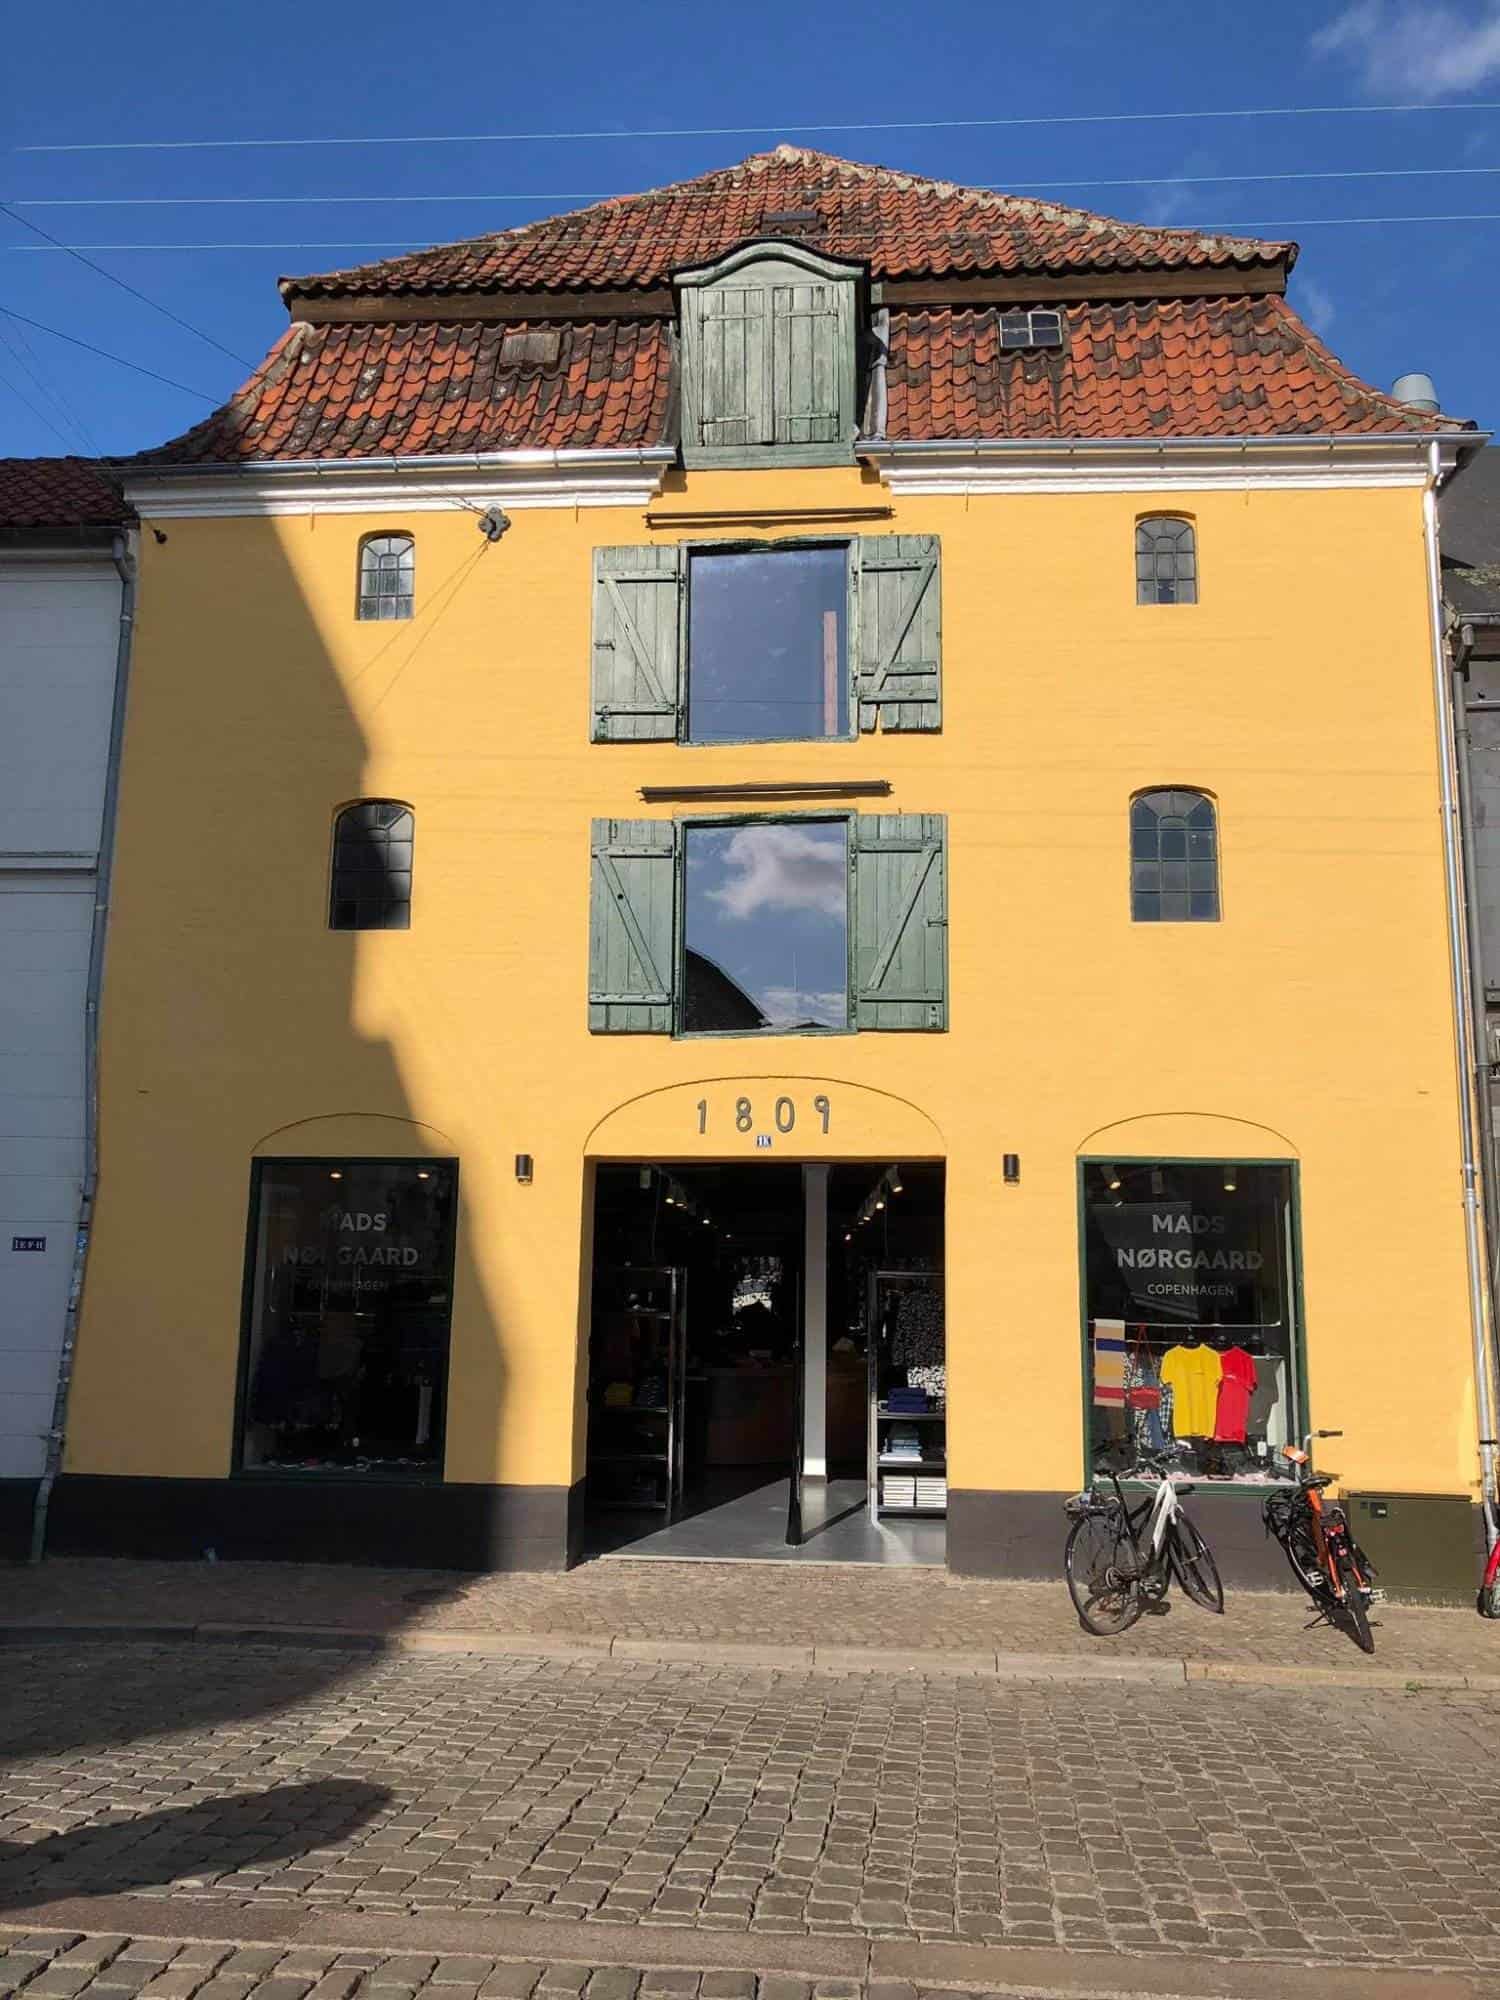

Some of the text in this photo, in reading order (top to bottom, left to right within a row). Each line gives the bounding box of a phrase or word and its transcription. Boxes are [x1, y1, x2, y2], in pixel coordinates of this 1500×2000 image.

[697, 1095, 830, 1134] 1809
[1152, 1214, 1225, 1233] MADS
[1117, 1248, 1265, 1270] NØRGAARD
[1147, 1283, 1235, 1297] COPENHAGEN
